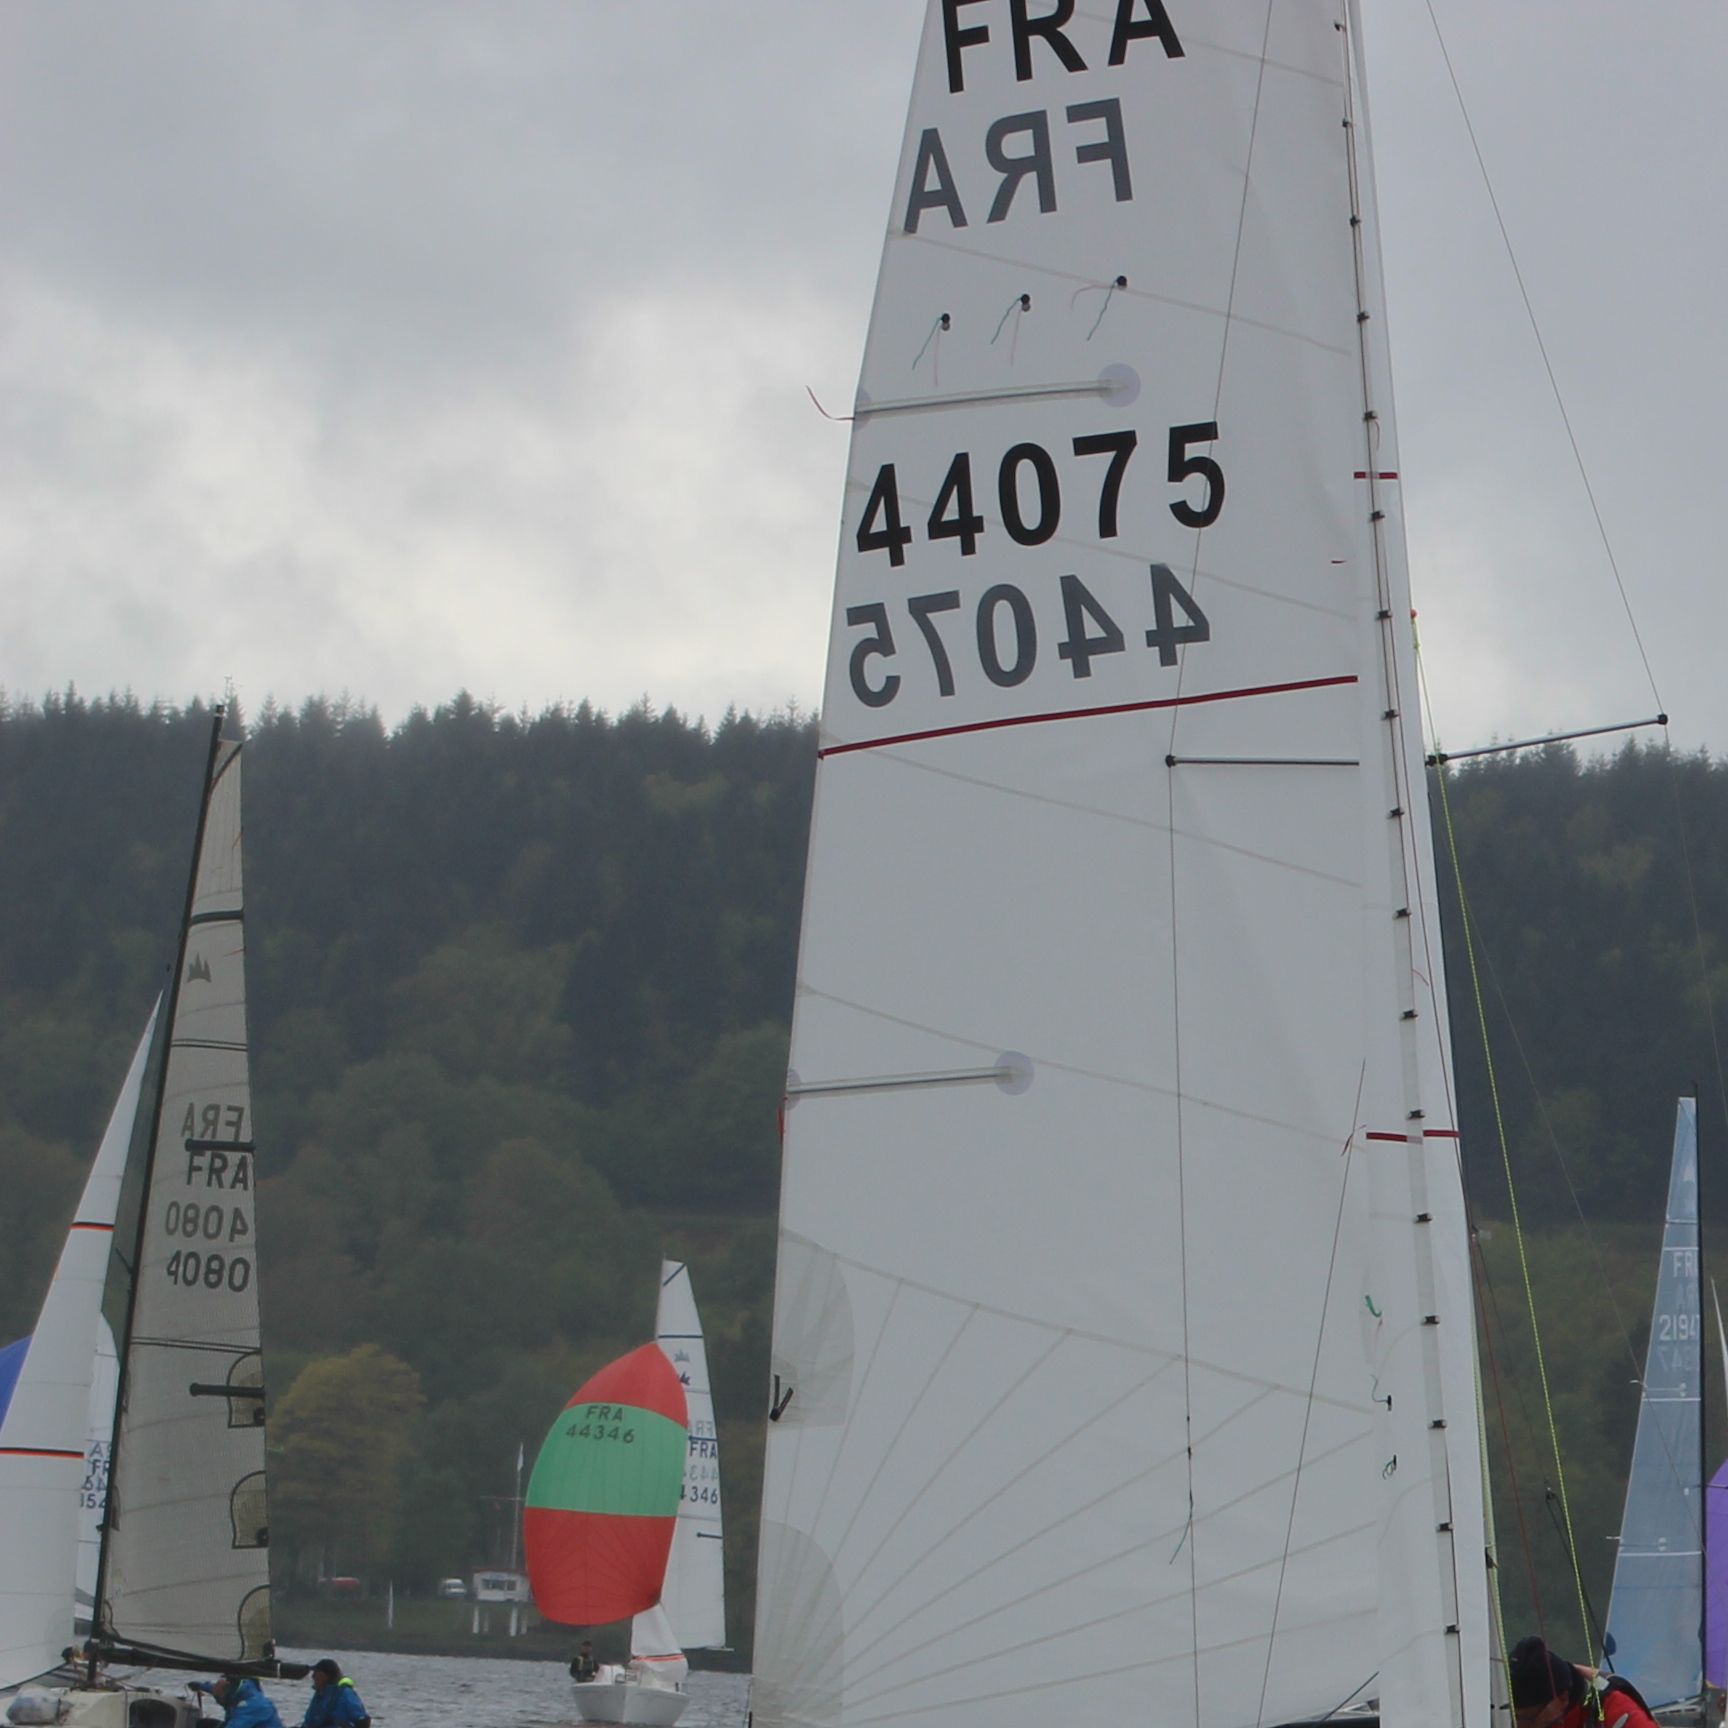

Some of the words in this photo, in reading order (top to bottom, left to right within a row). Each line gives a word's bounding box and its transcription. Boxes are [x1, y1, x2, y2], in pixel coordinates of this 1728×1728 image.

[941, 0, 1186, 94] FRA
[856, 421, 1226, 568] 44075
[187, 1150, 249, 1191] FRA
[166, 1249, 251, 1293] 4080
[585, 1405, 625, 1421] FRA
[566, 1424, 635, 1444] 44346
[689, 1440, 717, 1459] FRA
